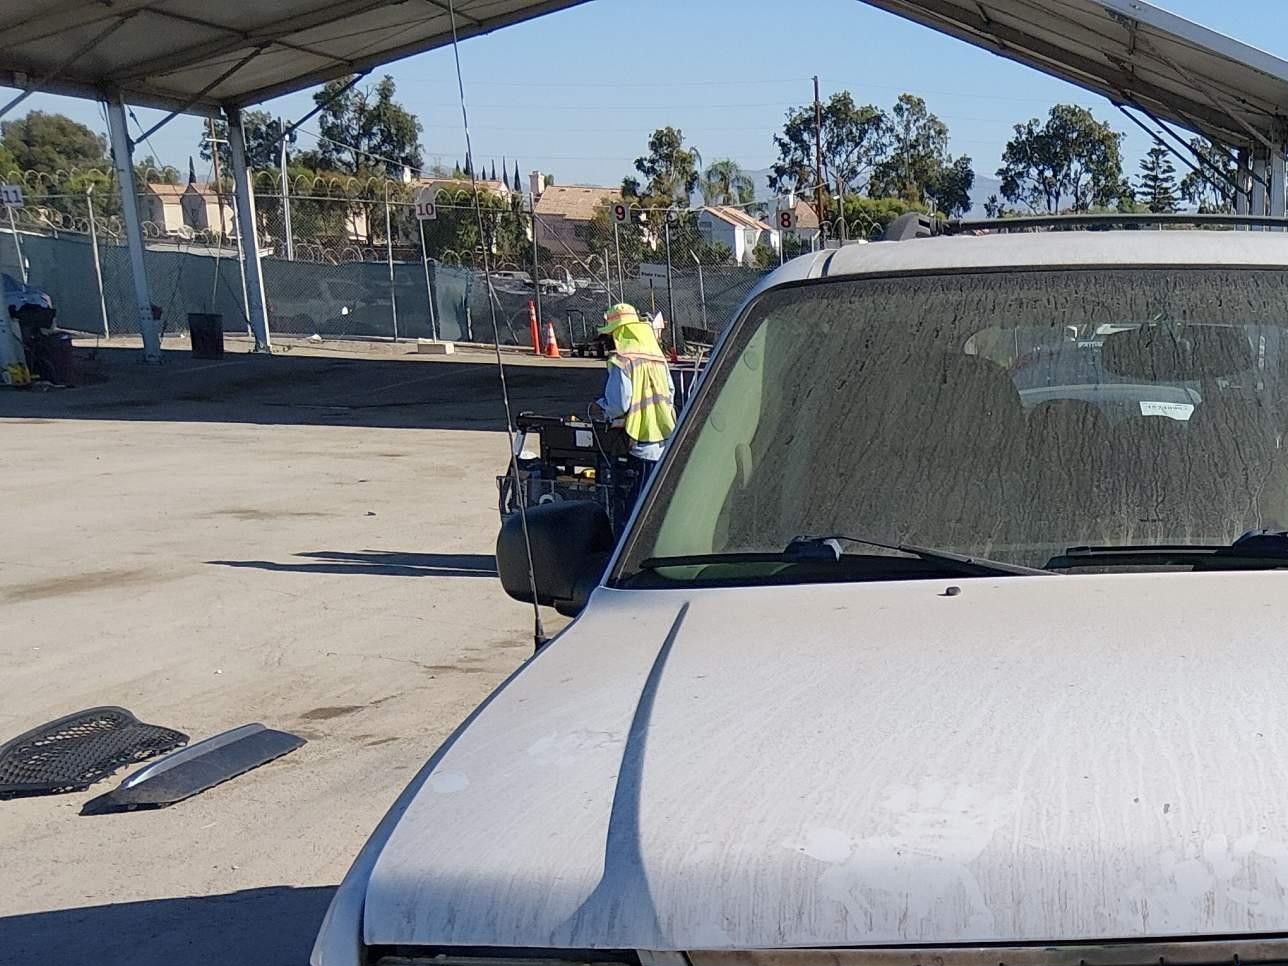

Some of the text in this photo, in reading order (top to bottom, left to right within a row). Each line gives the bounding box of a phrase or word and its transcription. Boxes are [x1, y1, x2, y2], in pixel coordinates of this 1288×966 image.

[3, 190, 22, 204] 11
[416, 202, 435, 216] 10
[614, 204, 626, 221] 9
[780, 211, 792, 229] 8
